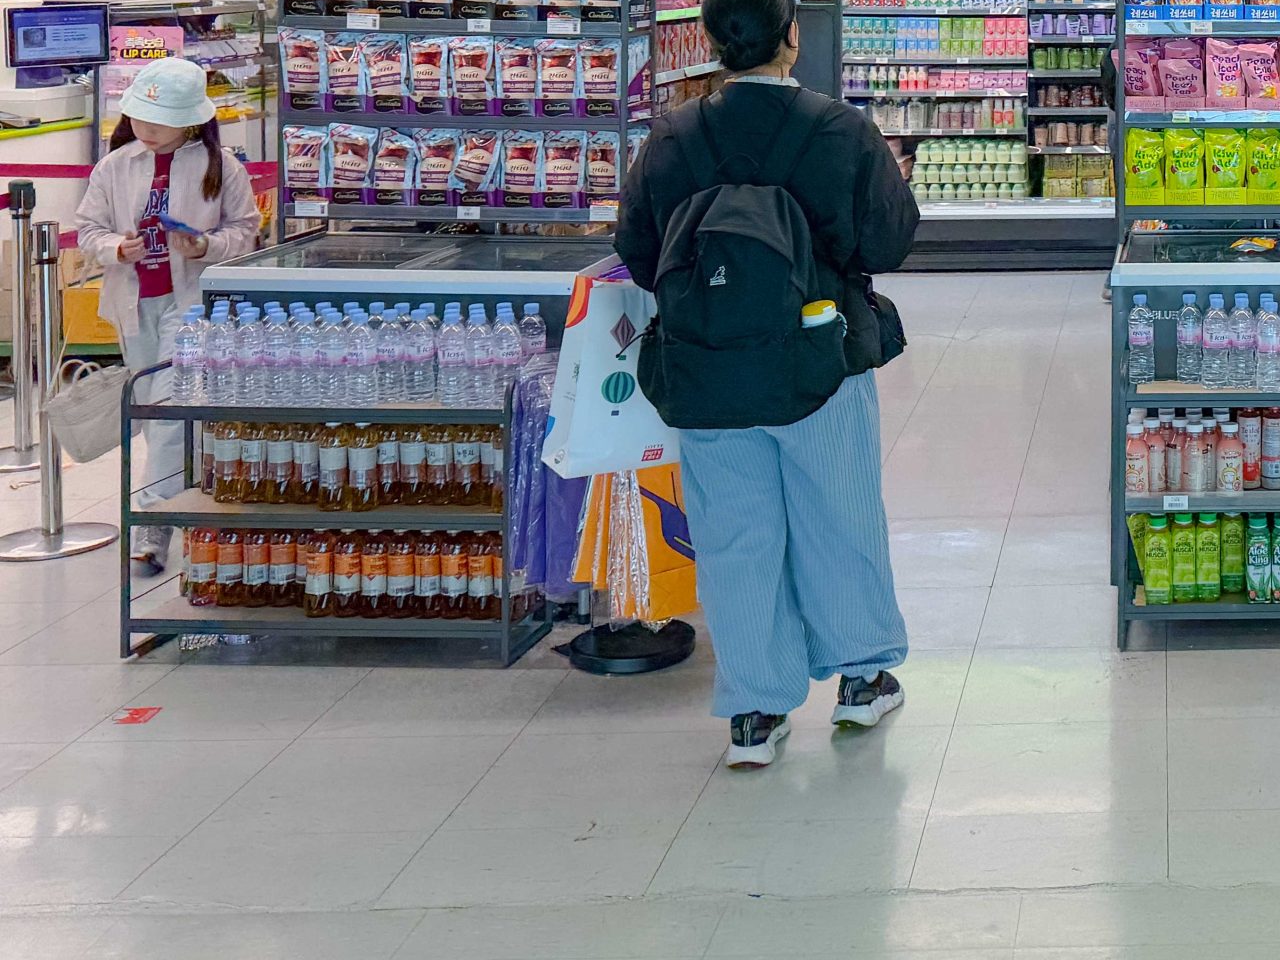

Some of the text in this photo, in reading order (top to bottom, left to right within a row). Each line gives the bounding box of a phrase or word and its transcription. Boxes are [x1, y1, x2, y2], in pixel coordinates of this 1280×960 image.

[123, 49, 168, 58] LIP CARE
[1248, 546, 1268, 555] Aloe
[1249, 555, 1269, 565] King
